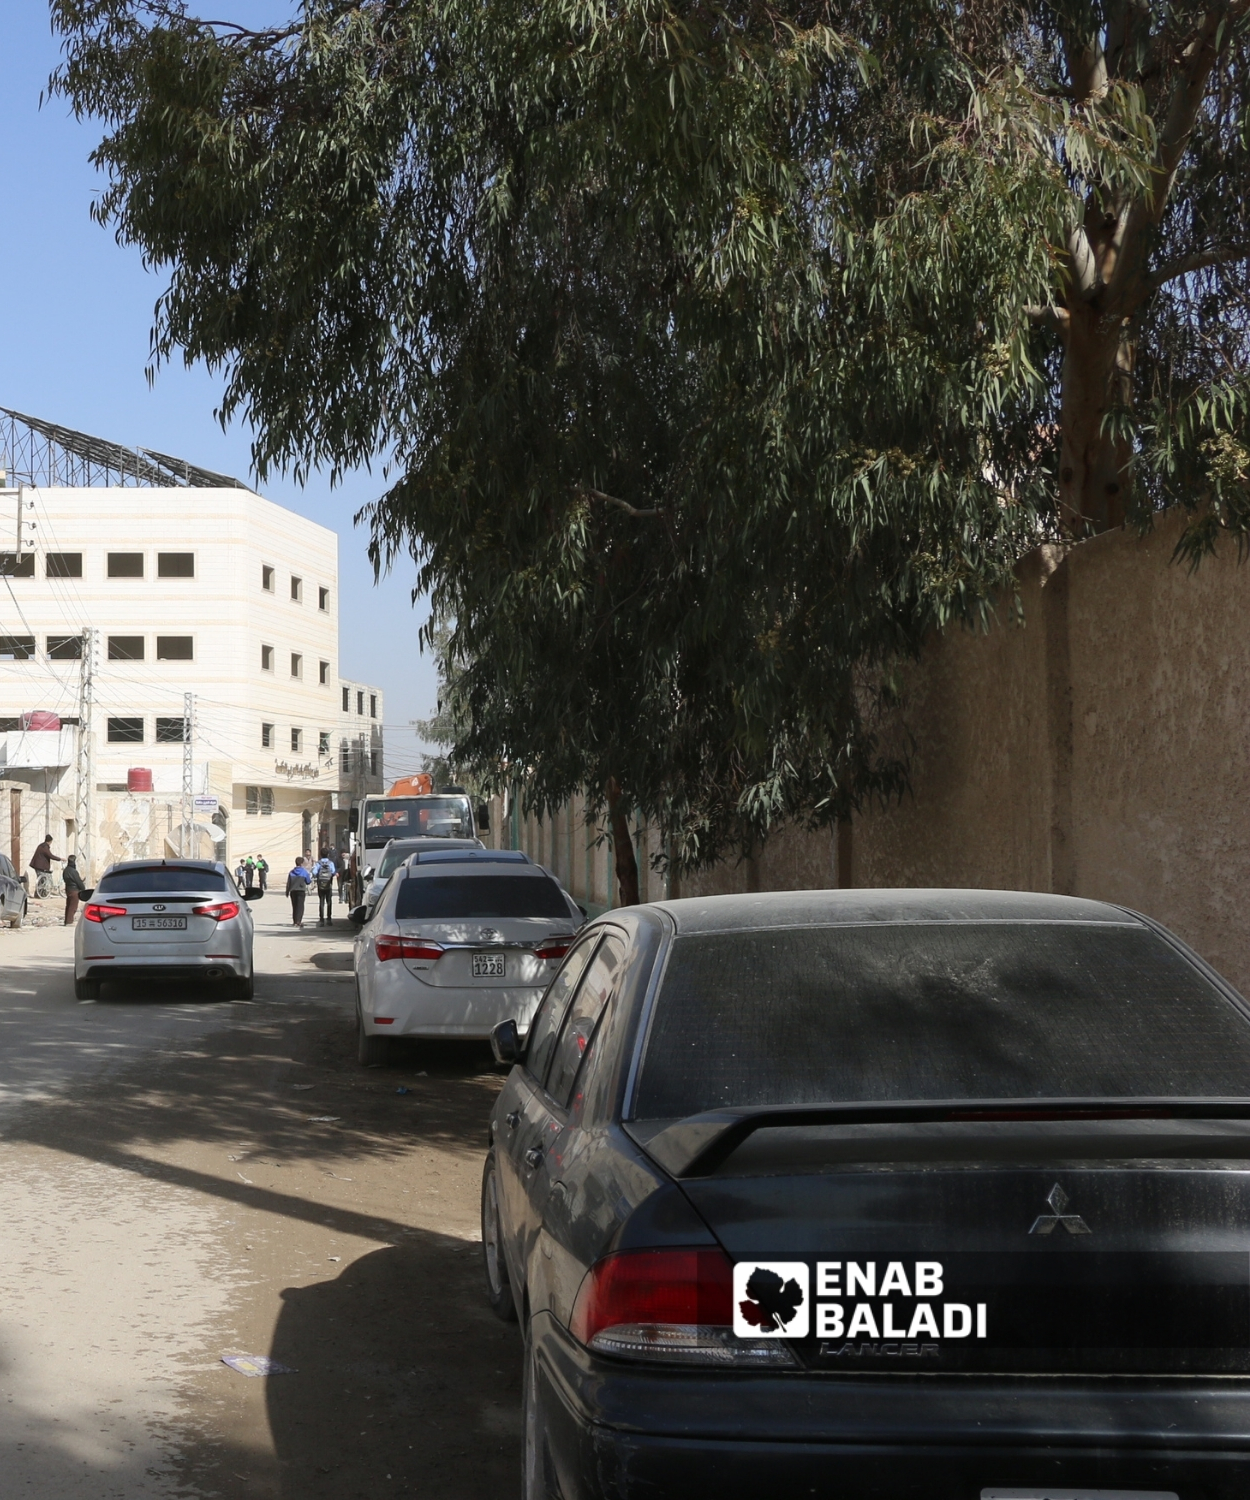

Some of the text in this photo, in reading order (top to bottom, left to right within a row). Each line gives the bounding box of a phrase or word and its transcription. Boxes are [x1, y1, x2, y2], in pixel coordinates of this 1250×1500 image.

[136, 919, 147, 928] 15
[157, 918, 183, 928] 56316
[474, 955, 487, 963] 542
[475, 963, 503, 975] 1228
[819, 1341, 940, 1357] LANCER
